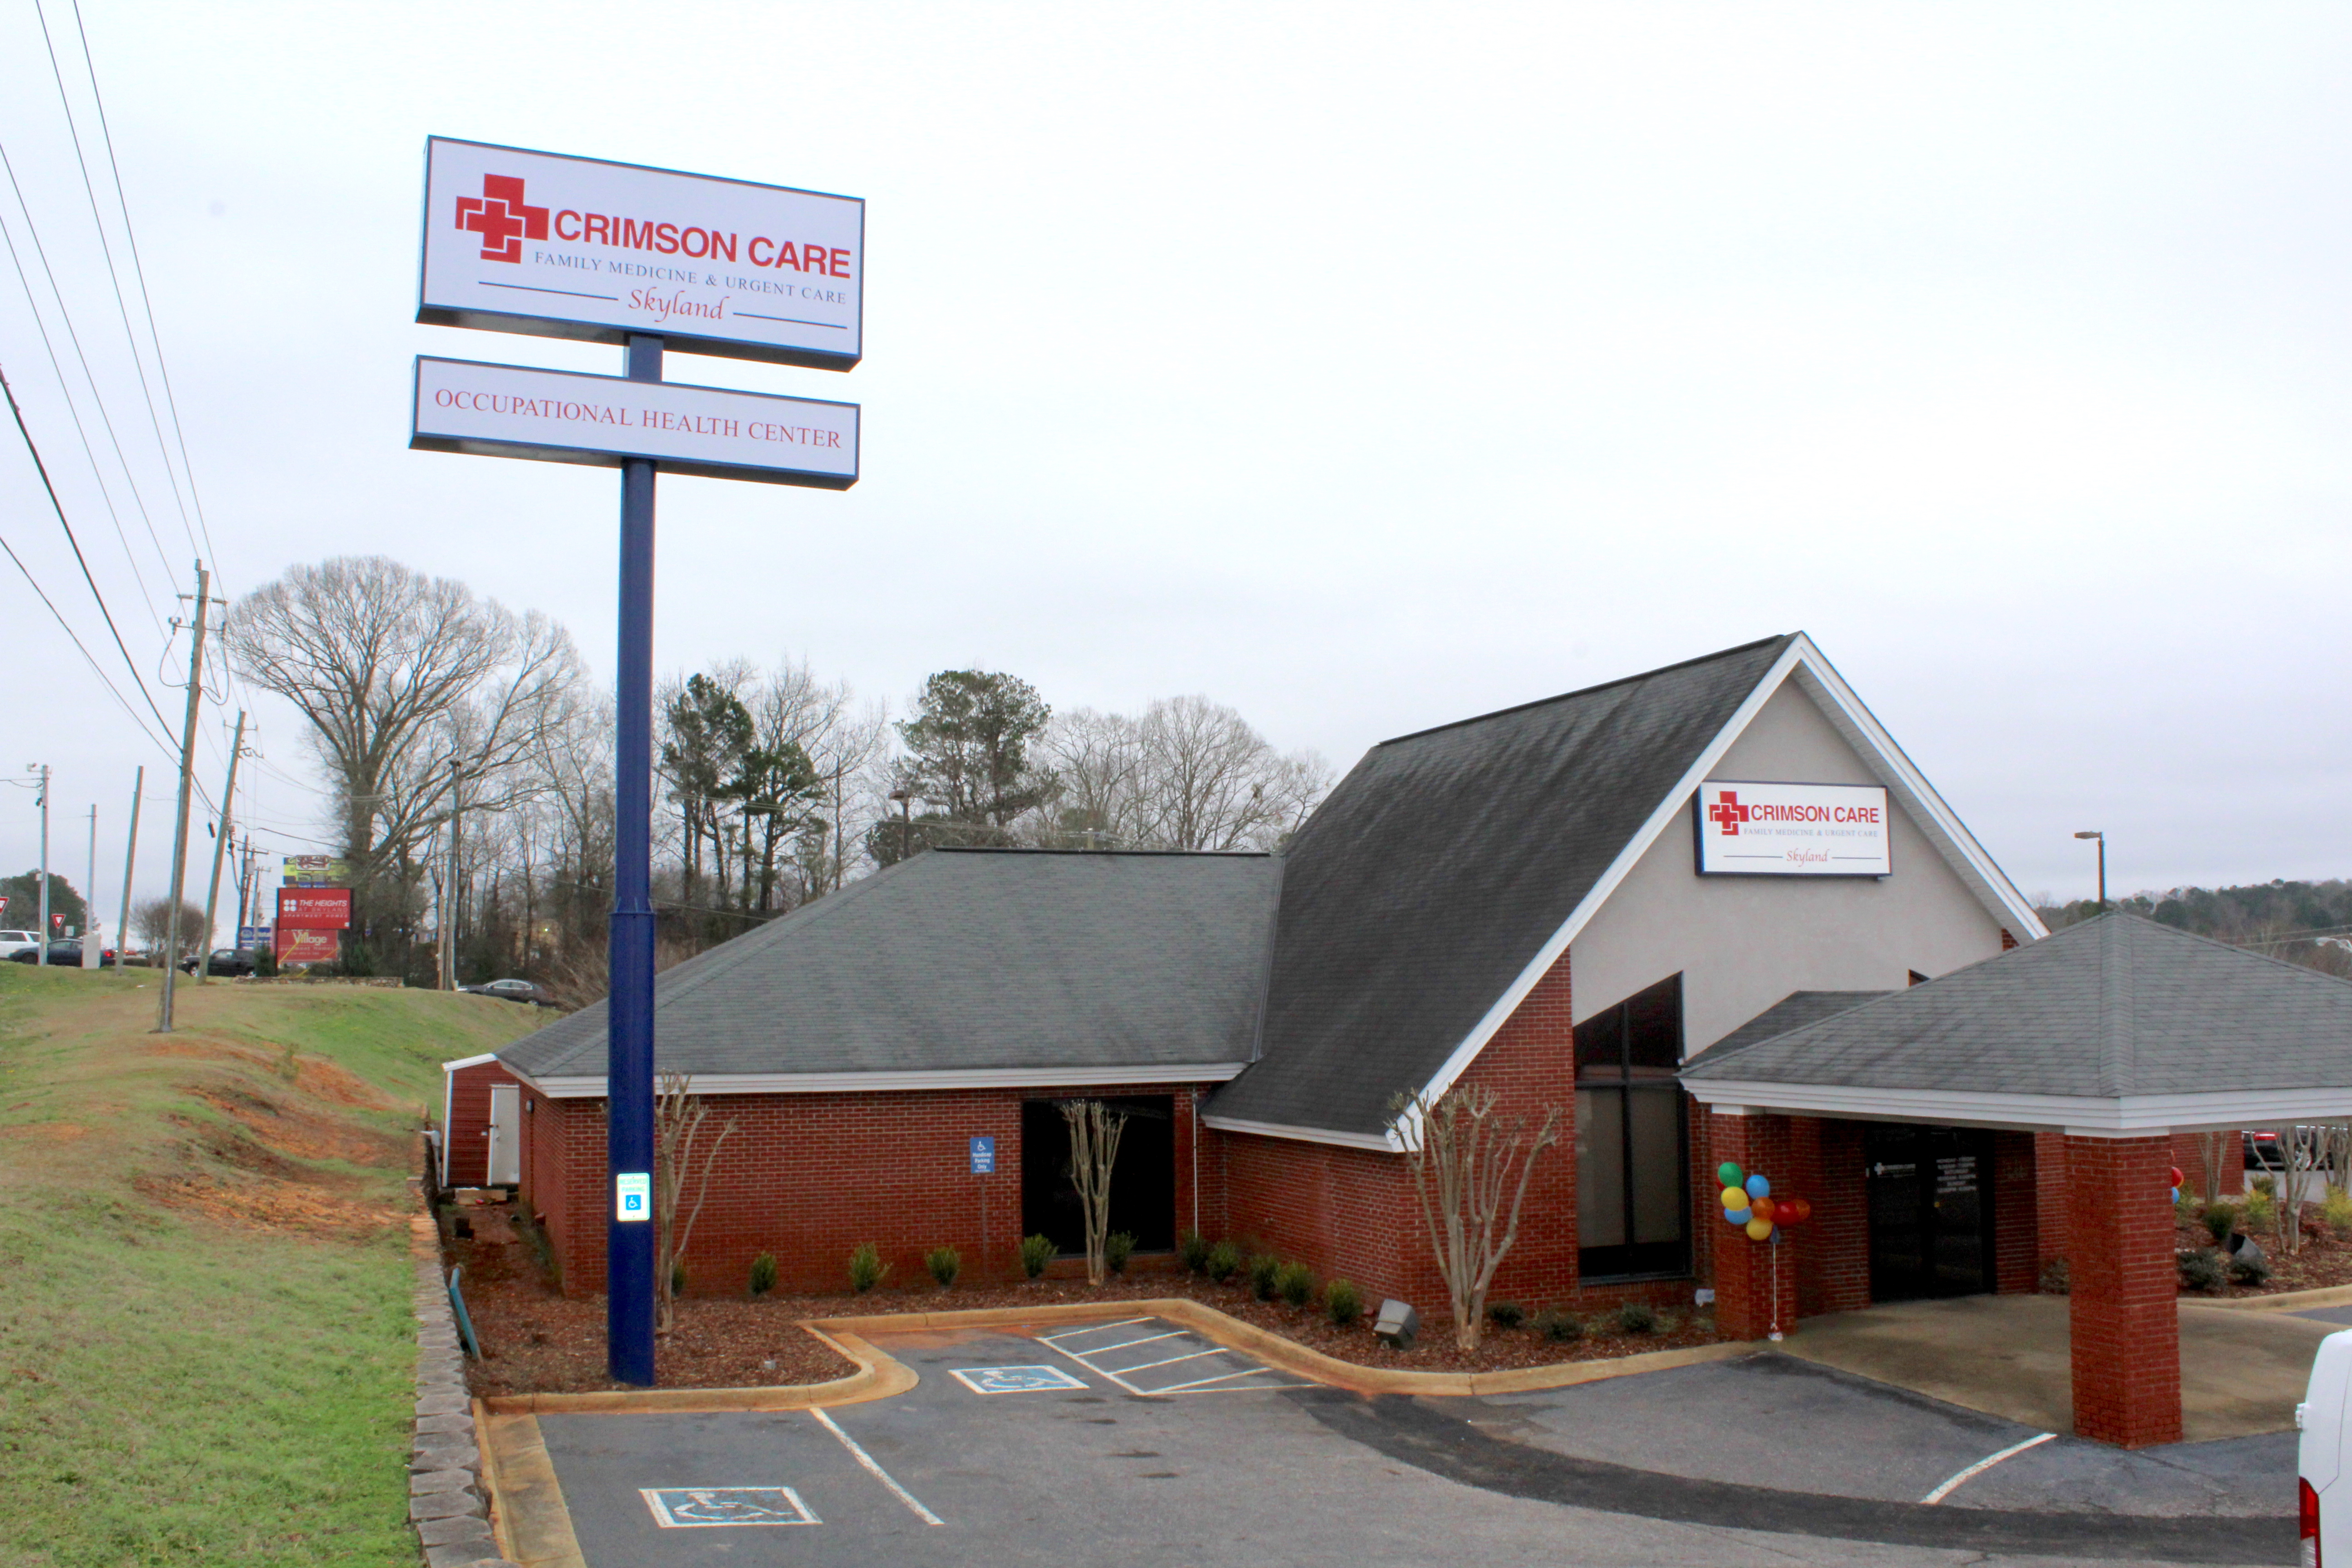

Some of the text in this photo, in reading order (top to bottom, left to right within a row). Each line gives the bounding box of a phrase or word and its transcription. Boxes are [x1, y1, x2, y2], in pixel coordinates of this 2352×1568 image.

[554, 209, 850, 279] CRIMSON CARE
[535, 251, 847, 304] FAMILY MEDICINE & URGENT CARE
[628, 289, 730, 322] Skyland
[435, 389, 841, 449] OCCUPATIONAL HEALTH CENTER
[1751, 804, 1879, 823] CRIMSON CARE
[1786, 848, 1830, 867] Skyland
[292, 931, 328, 946] Village
